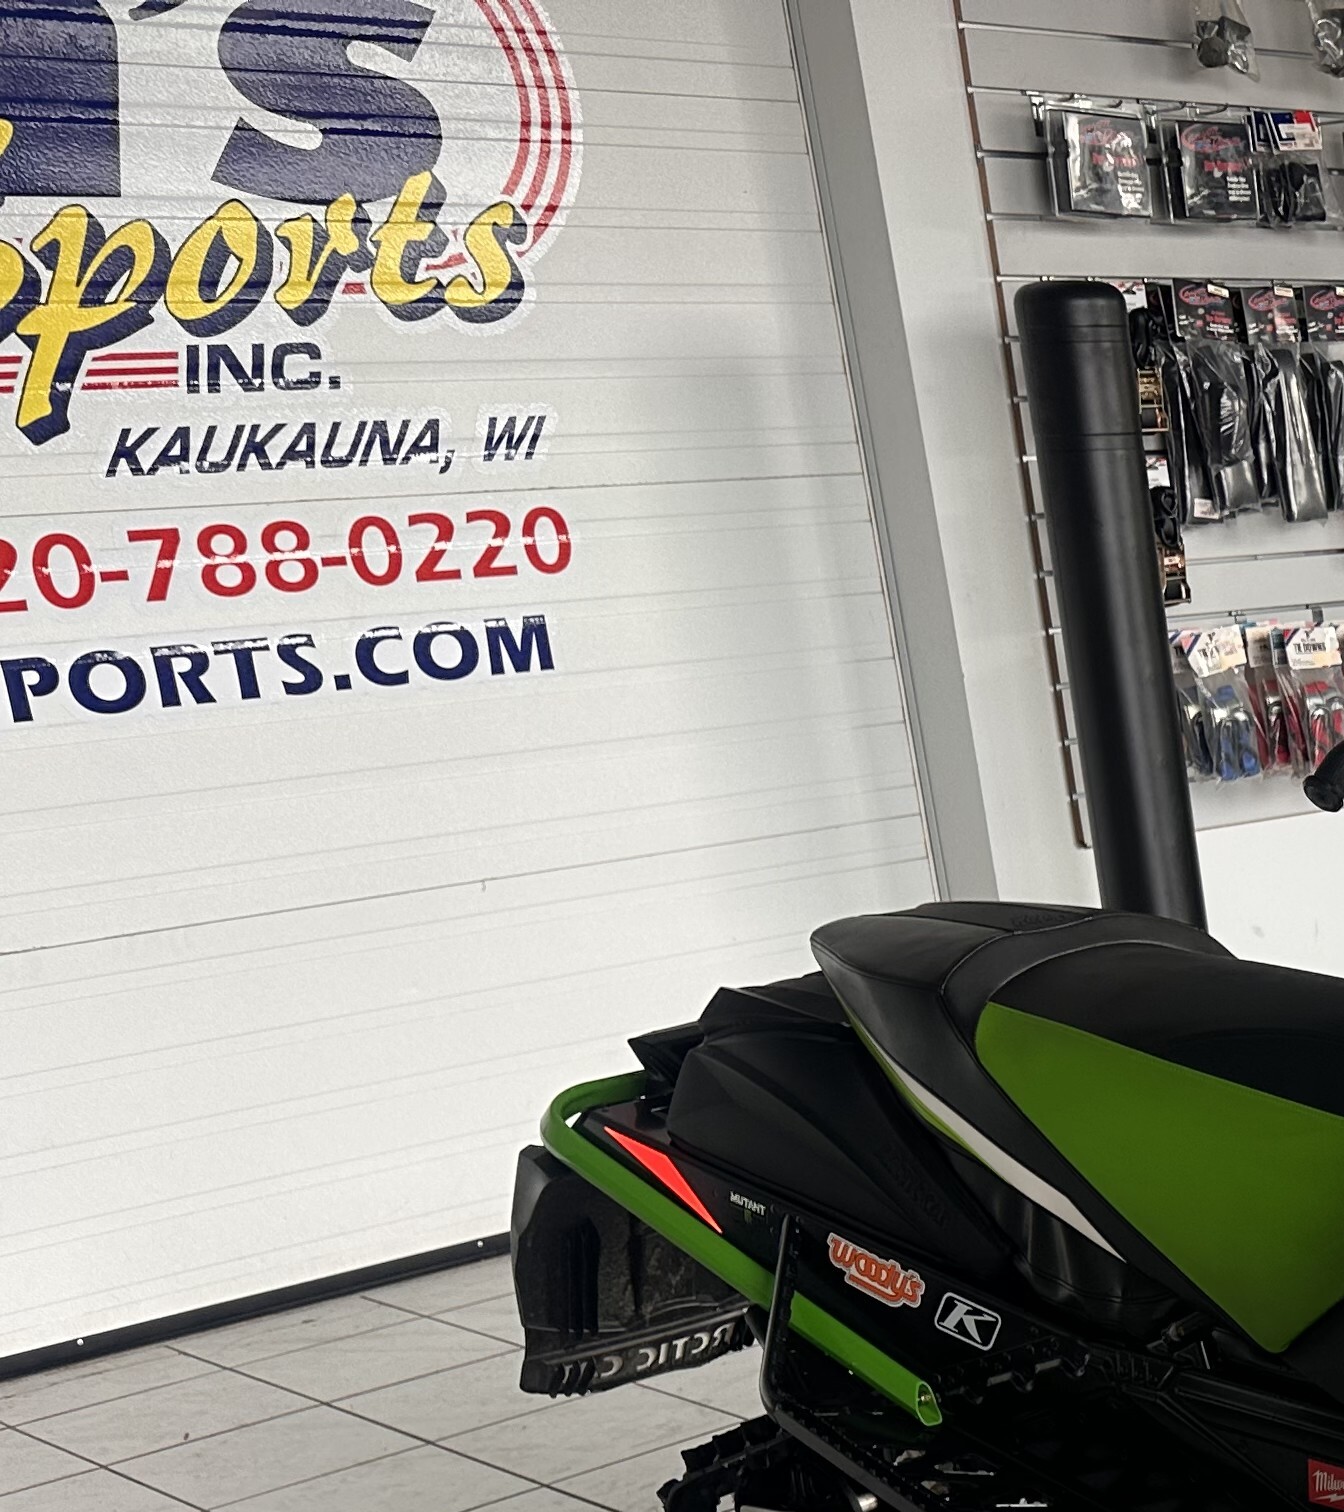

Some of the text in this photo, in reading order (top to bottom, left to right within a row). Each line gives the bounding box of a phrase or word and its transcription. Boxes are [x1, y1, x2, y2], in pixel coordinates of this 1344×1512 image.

[184, 341, 342, 396] INC.
[104, 415, 547, 480] KAUKAUNA, WI
[729, 1190, 767, 1217] MUTANT
